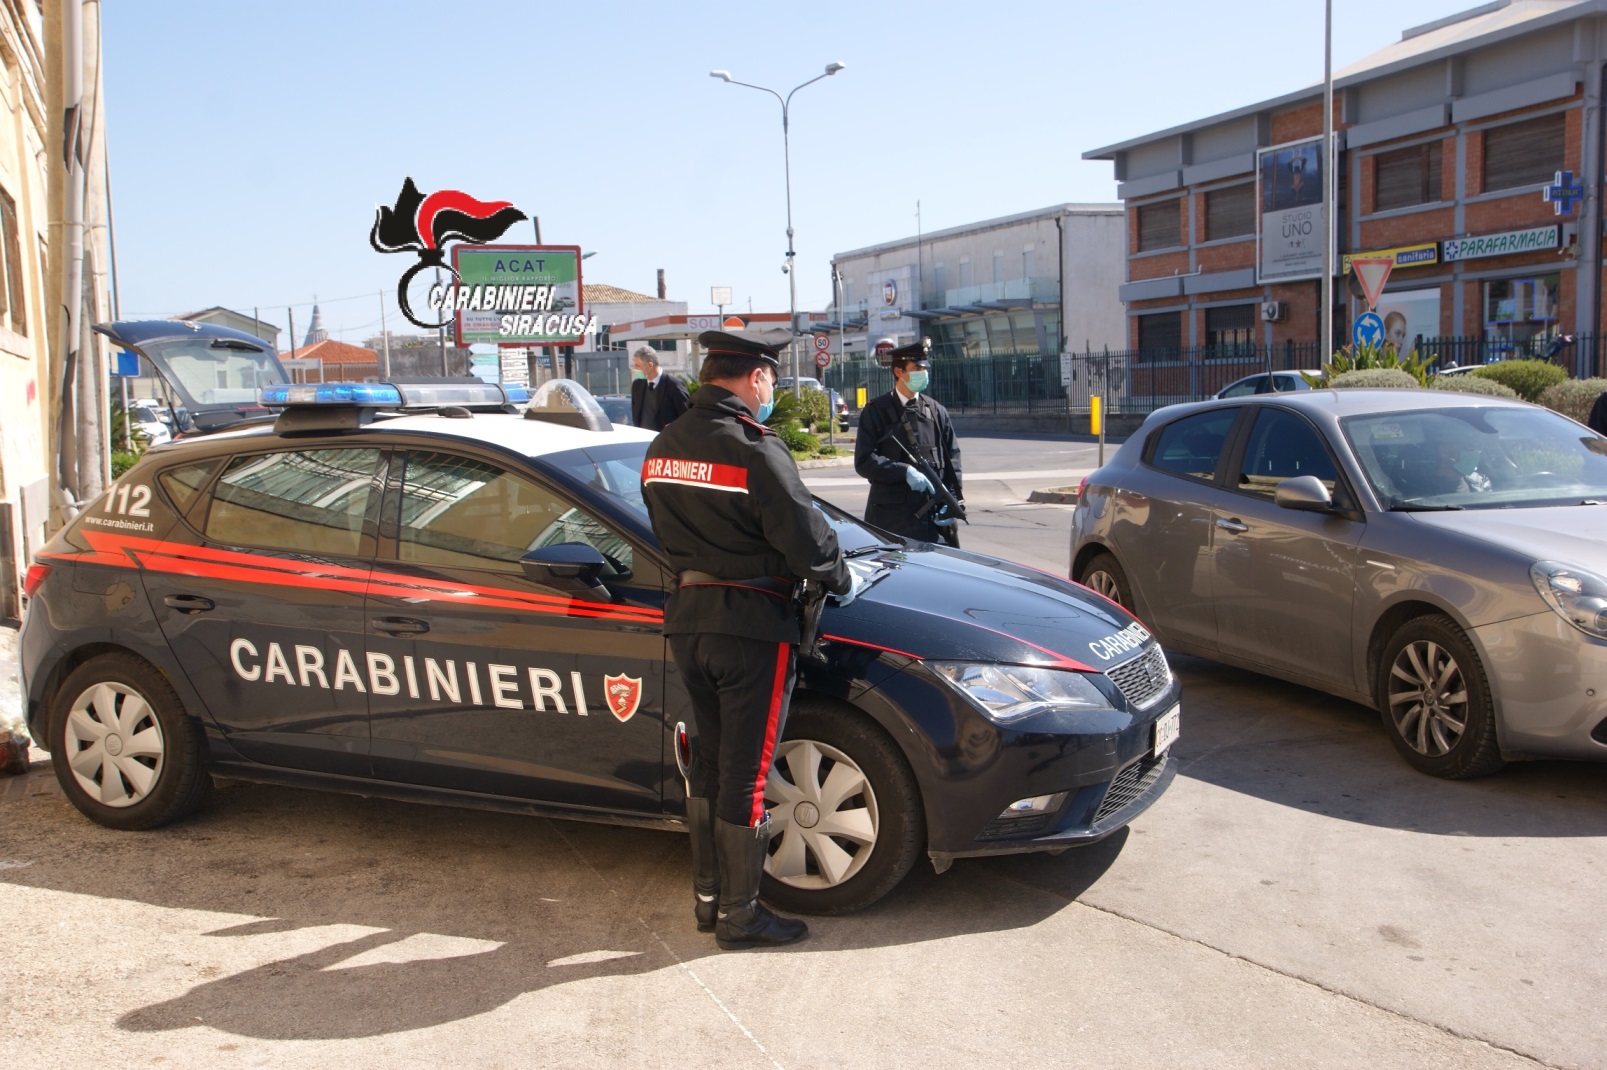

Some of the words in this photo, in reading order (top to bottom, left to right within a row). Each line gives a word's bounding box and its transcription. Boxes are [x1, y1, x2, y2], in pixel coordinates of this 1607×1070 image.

[1283, 211, 1312, 224] STUDIO
[1282, 221, 1312, 238] UNO
[1459, 228, 1557, 258] PARAFARMACIA
[1398, 250, 1435, 264] sanitaria
[495, 260, 546, 273] ACAT
[817, 338, 827, 347] 50
[648, 459, 712, 482] CARABINIERI
[104, 483, 152, 517] 112
[85, 516, 154, 532] www.carabinieri.it
[230, 638, 589, 717] CARABINIERI
